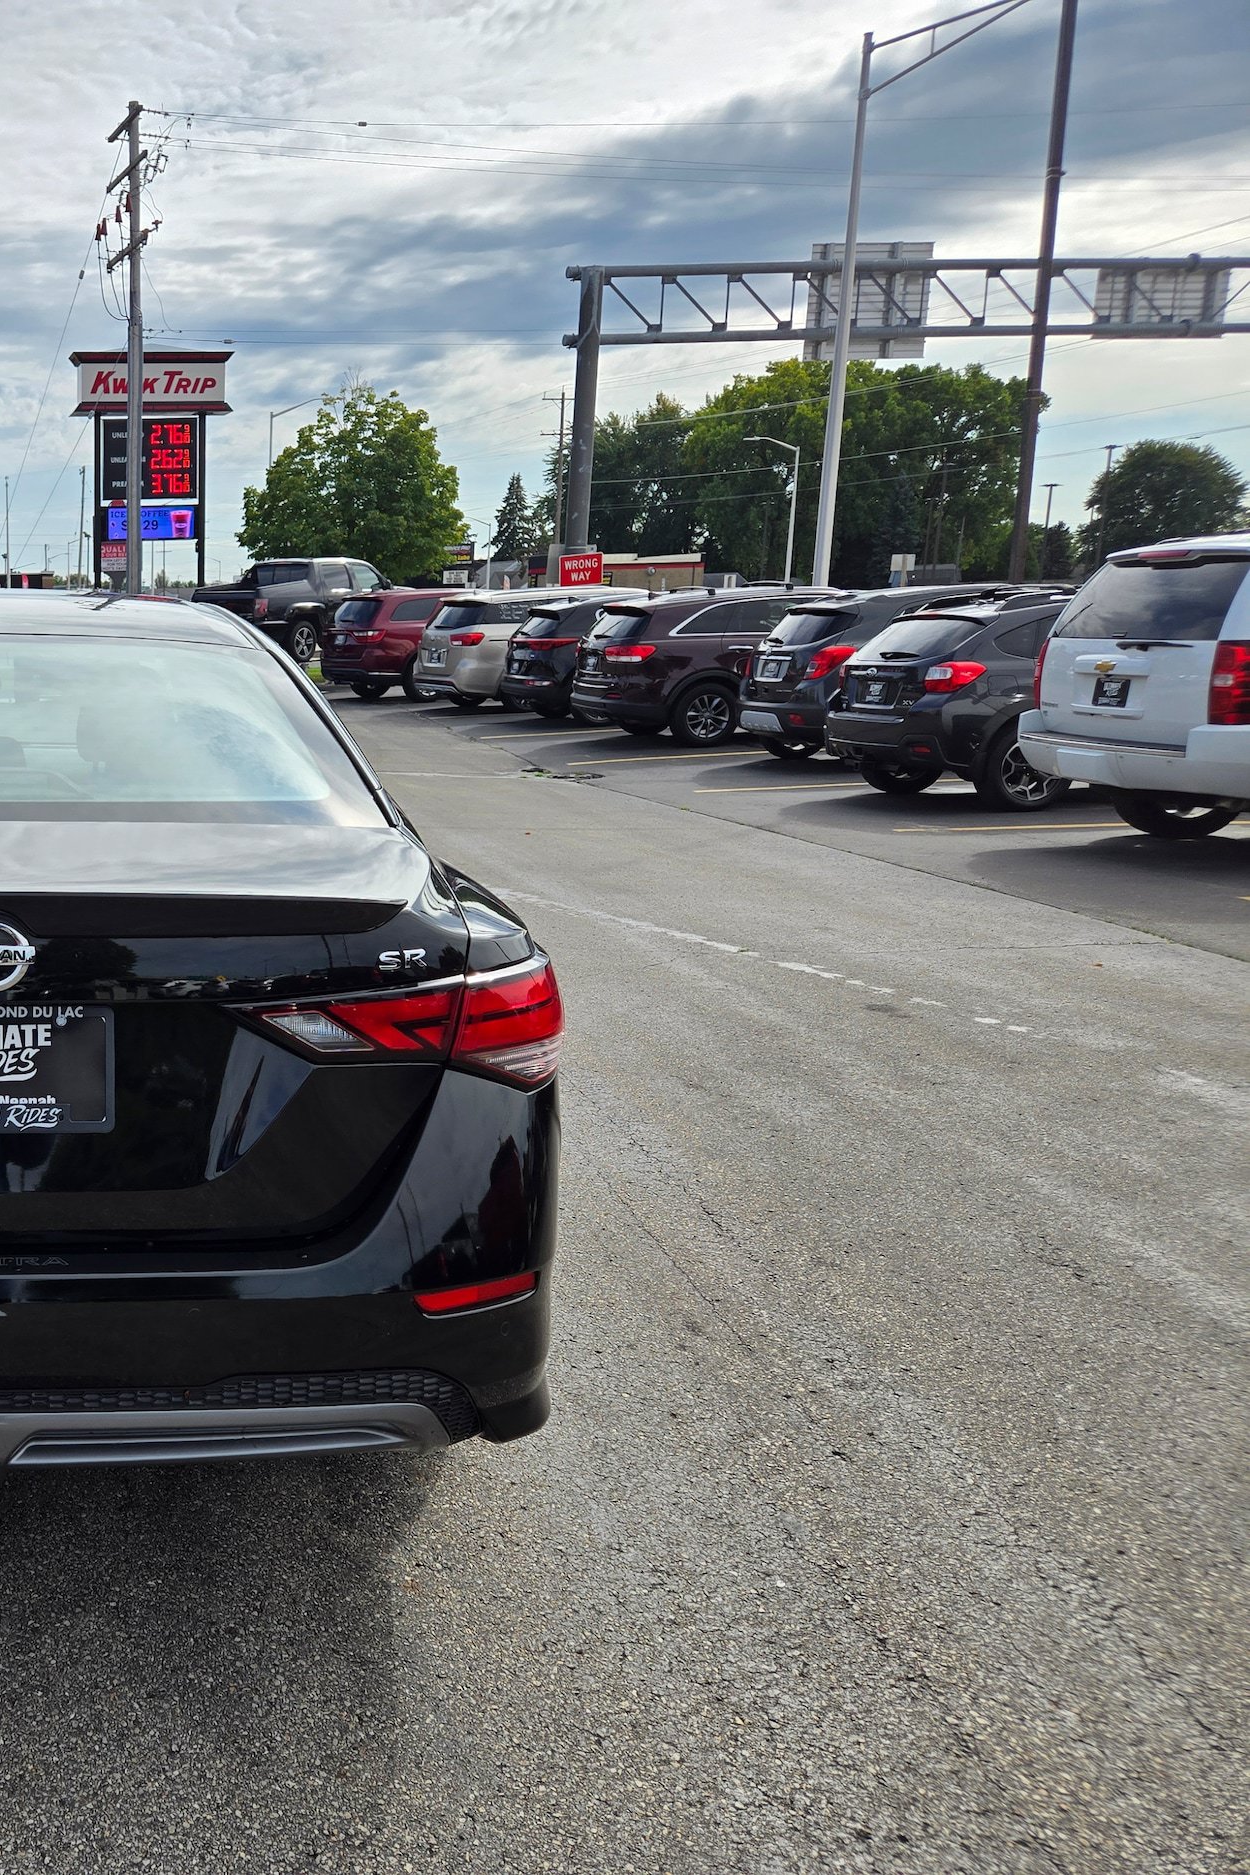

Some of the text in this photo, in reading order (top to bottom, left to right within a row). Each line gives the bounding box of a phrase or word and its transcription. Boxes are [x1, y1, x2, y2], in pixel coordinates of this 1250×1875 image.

[90, 371, 217, 394] KWK TRIP
[140, 510, 170, 518] OFFEE
[564, 558, 599, 571] WRONG
[570, 570, 592, 582] WAY
[378, 948, 428, 971] SR
[32, 1006, 53, 1018] DU
[57, 1006, 84, 1018] LAC
